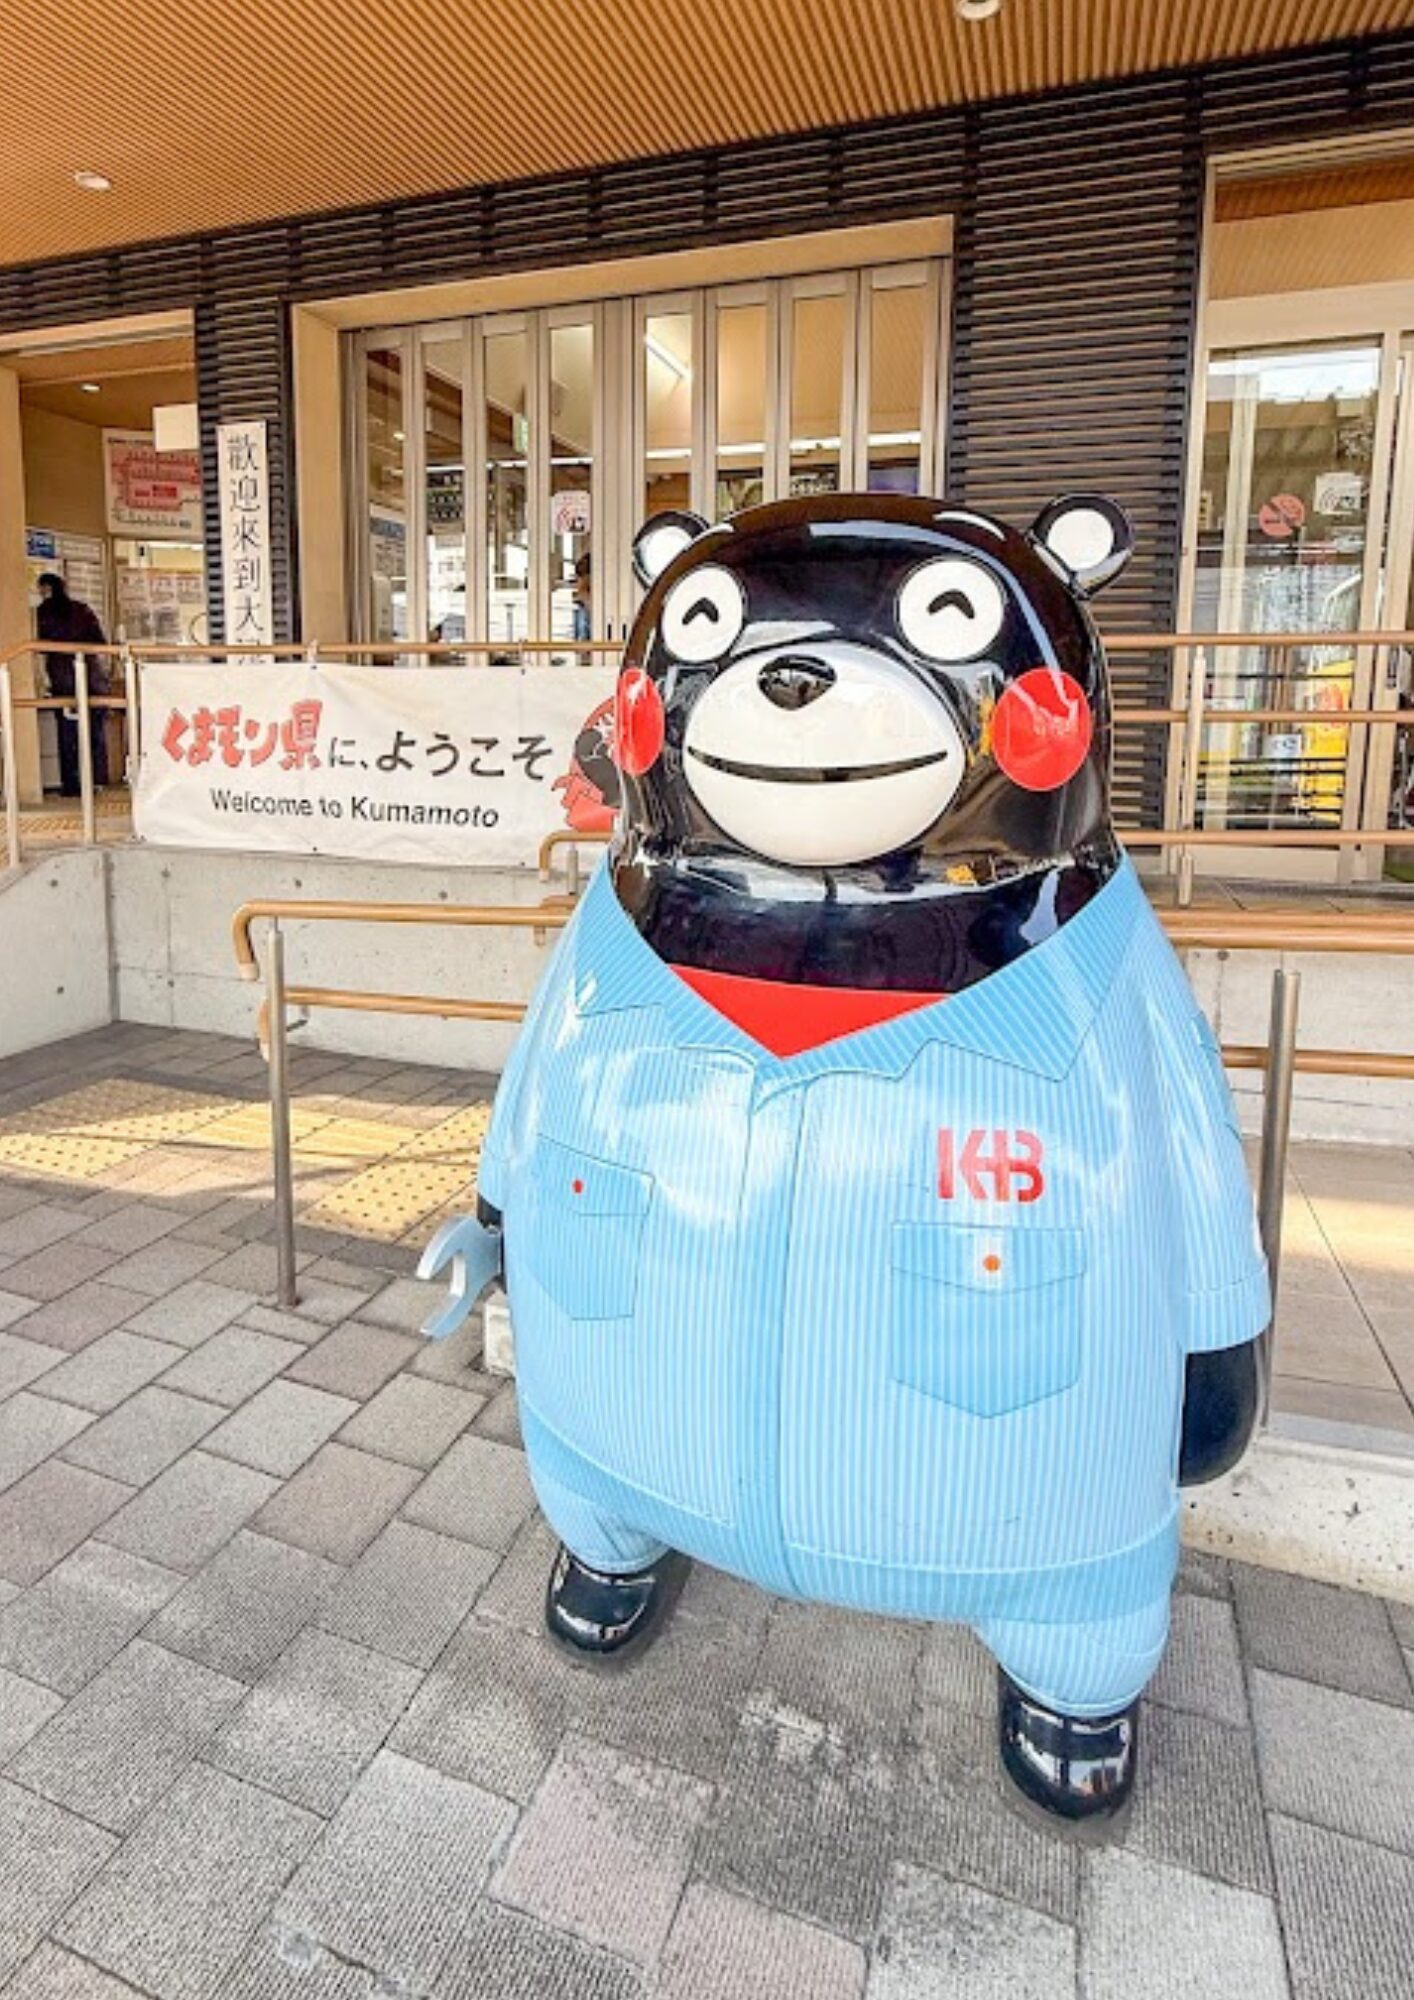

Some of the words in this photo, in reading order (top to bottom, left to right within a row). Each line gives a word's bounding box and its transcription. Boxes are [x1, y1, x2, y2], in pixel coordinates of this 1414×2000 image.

[210, 788, 314, 817] Welcome
[319, 796, 344, 820] to
[350, 796, 500, 830] Kumamoto
